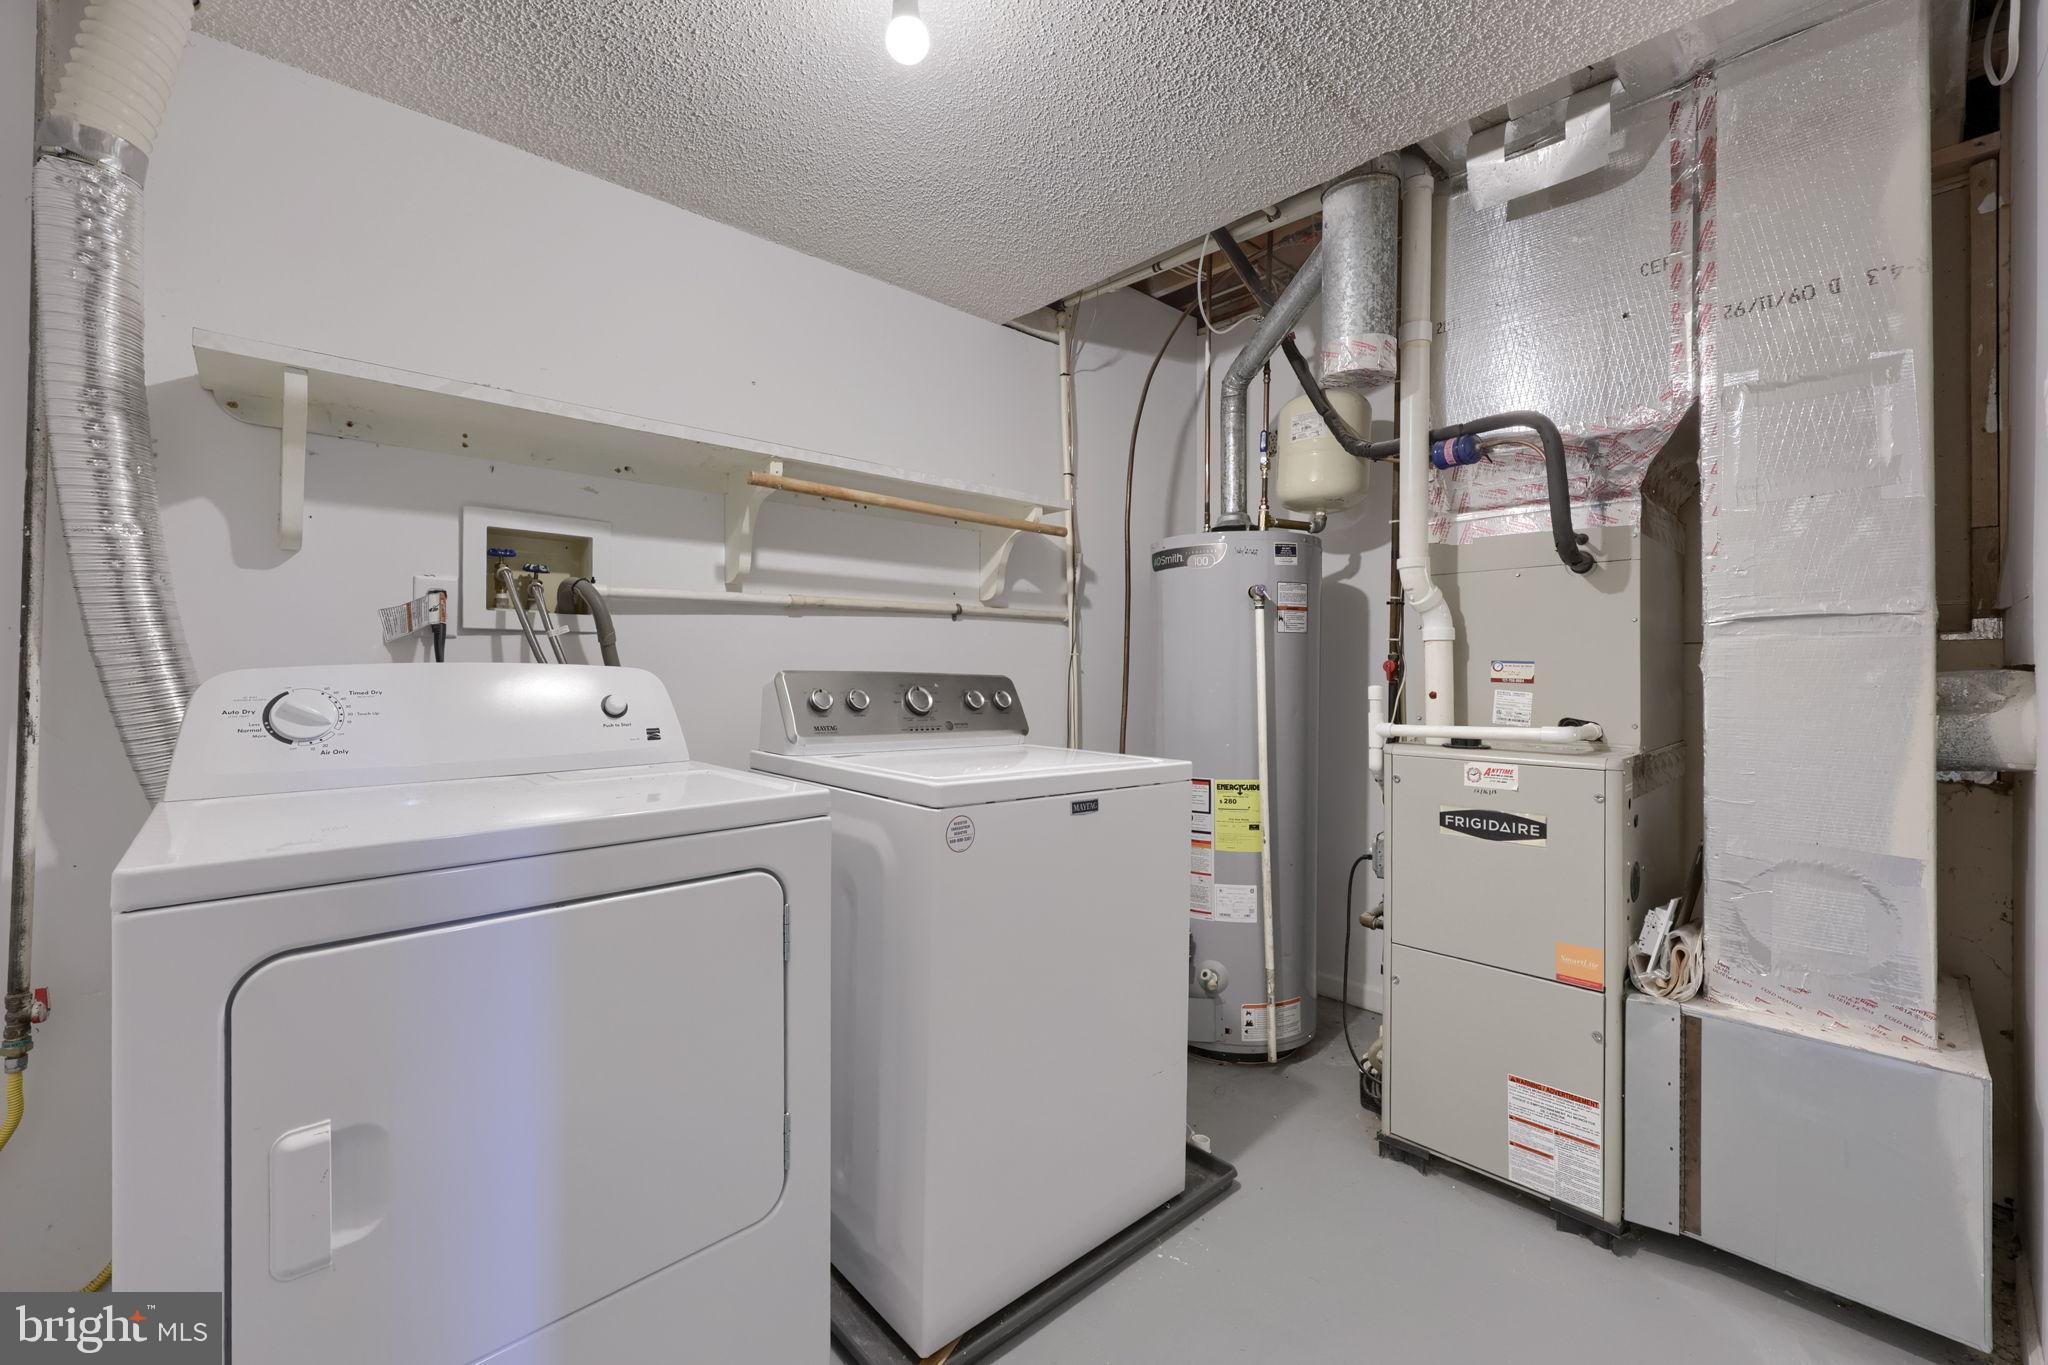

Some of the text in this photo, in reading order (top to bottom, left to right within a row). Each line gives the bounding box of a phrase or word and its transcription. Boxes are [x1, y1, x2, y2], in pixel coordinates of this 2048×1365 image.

[1194, 556, 1209, 567] 100
[333, 748, 349, 756] Only
[1483, 767, 1514, 777] ANYTIME
[1072, 801, 1098, 812] MAYTAG
[1445, 815, 1541, 838] FRIGIDAIRE
